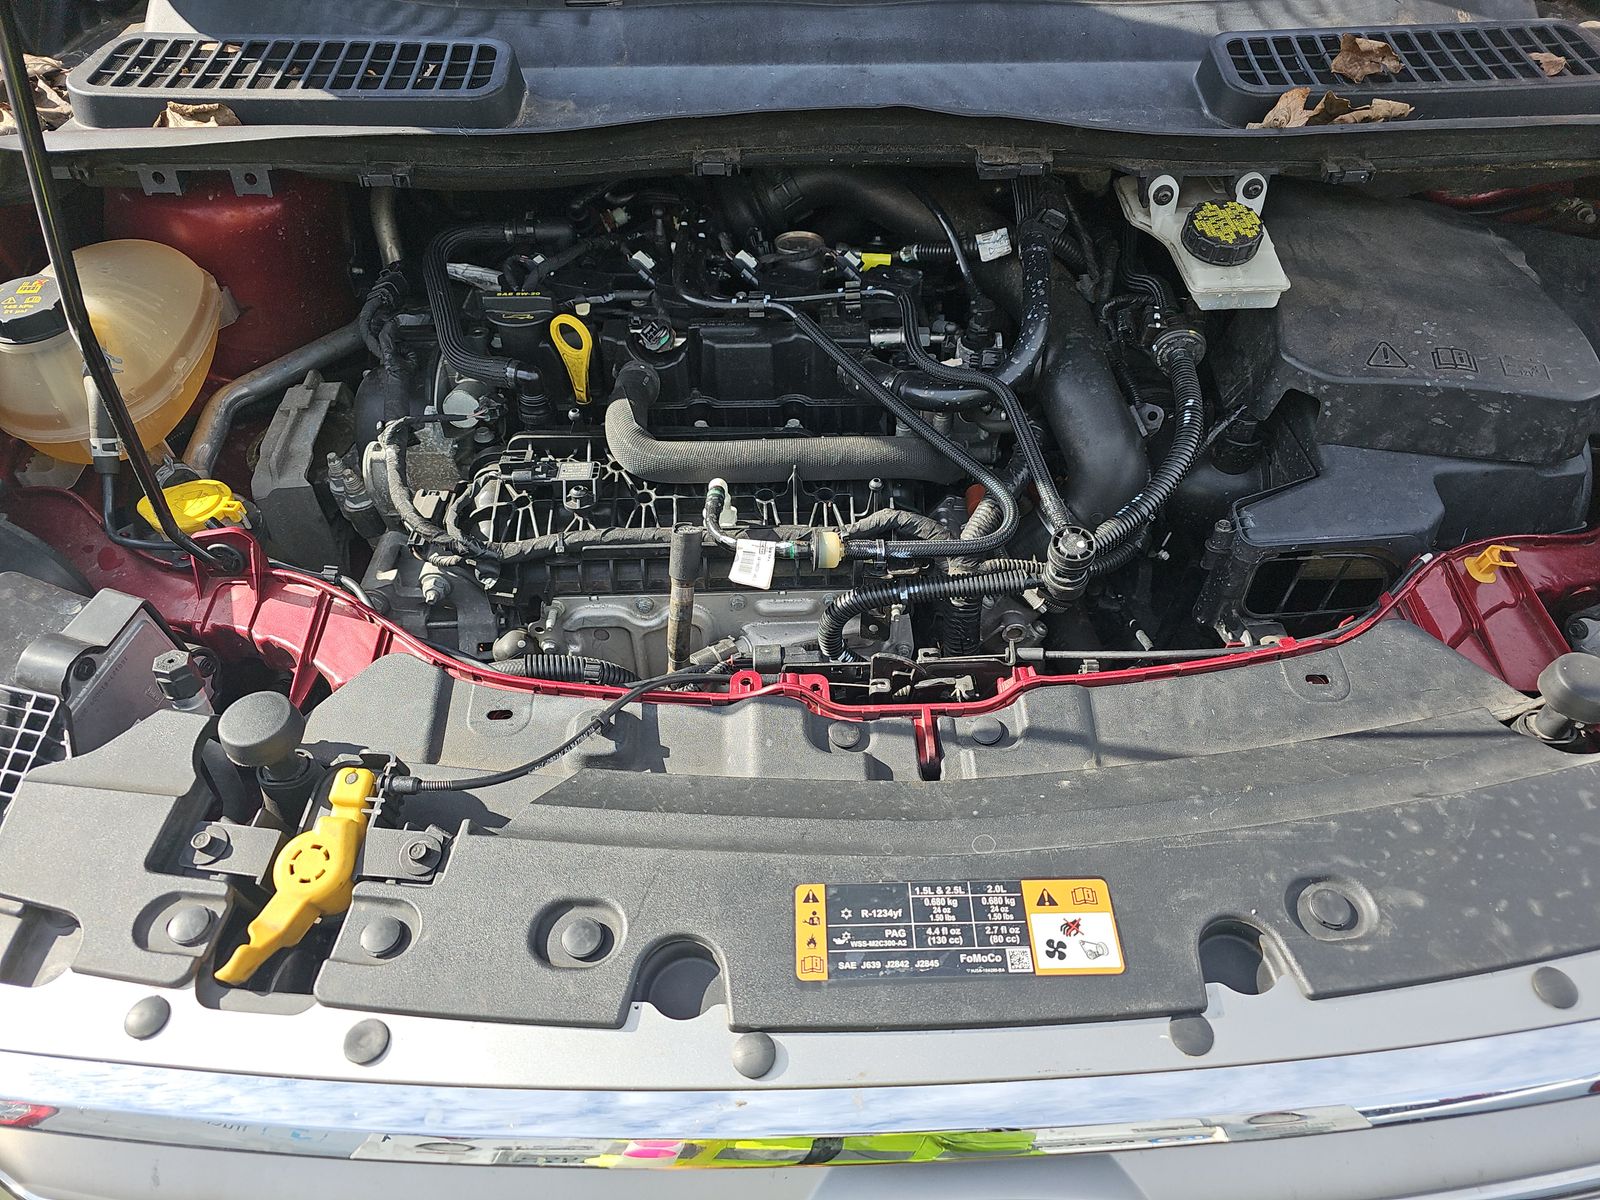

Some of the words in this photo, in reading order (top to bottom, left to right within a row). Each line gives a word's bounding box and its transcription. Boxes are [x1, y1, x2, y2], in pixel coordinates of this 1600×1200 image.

[914, 886, 934, 894] 1.5L
[945, 886, 965, 894] 2.5L
[986, 885, 1007, 893] 2.0L
[924, 898, 945, 906] 0.680
[947, 898, 958, 907] kg
[981, 897, 1003, 905] 0.680
[1005, 896, 1016, 906] kg
[861, 909, 903, 919] R-1234yf
[884, 929, 906, 938] PAG
[926, 927, 941, 936] 4.4
[941, 927, 948, 935] fl
[985, 926, 998, 935] 2.7
[1000, 926, 1007, 934] fl
[928, 936, 947, 946] (130
[948, 936, 963, 945] cc)
[990, 935, 1003, 945] (80
[1005, 935, 1020, 944] cc)
[960, 953, 1002, 963] FoMoCo
[838, 962, 857, 970] SAE
[861, 961, 881, 969] J639
[914, 960, 940, 968] J2845
